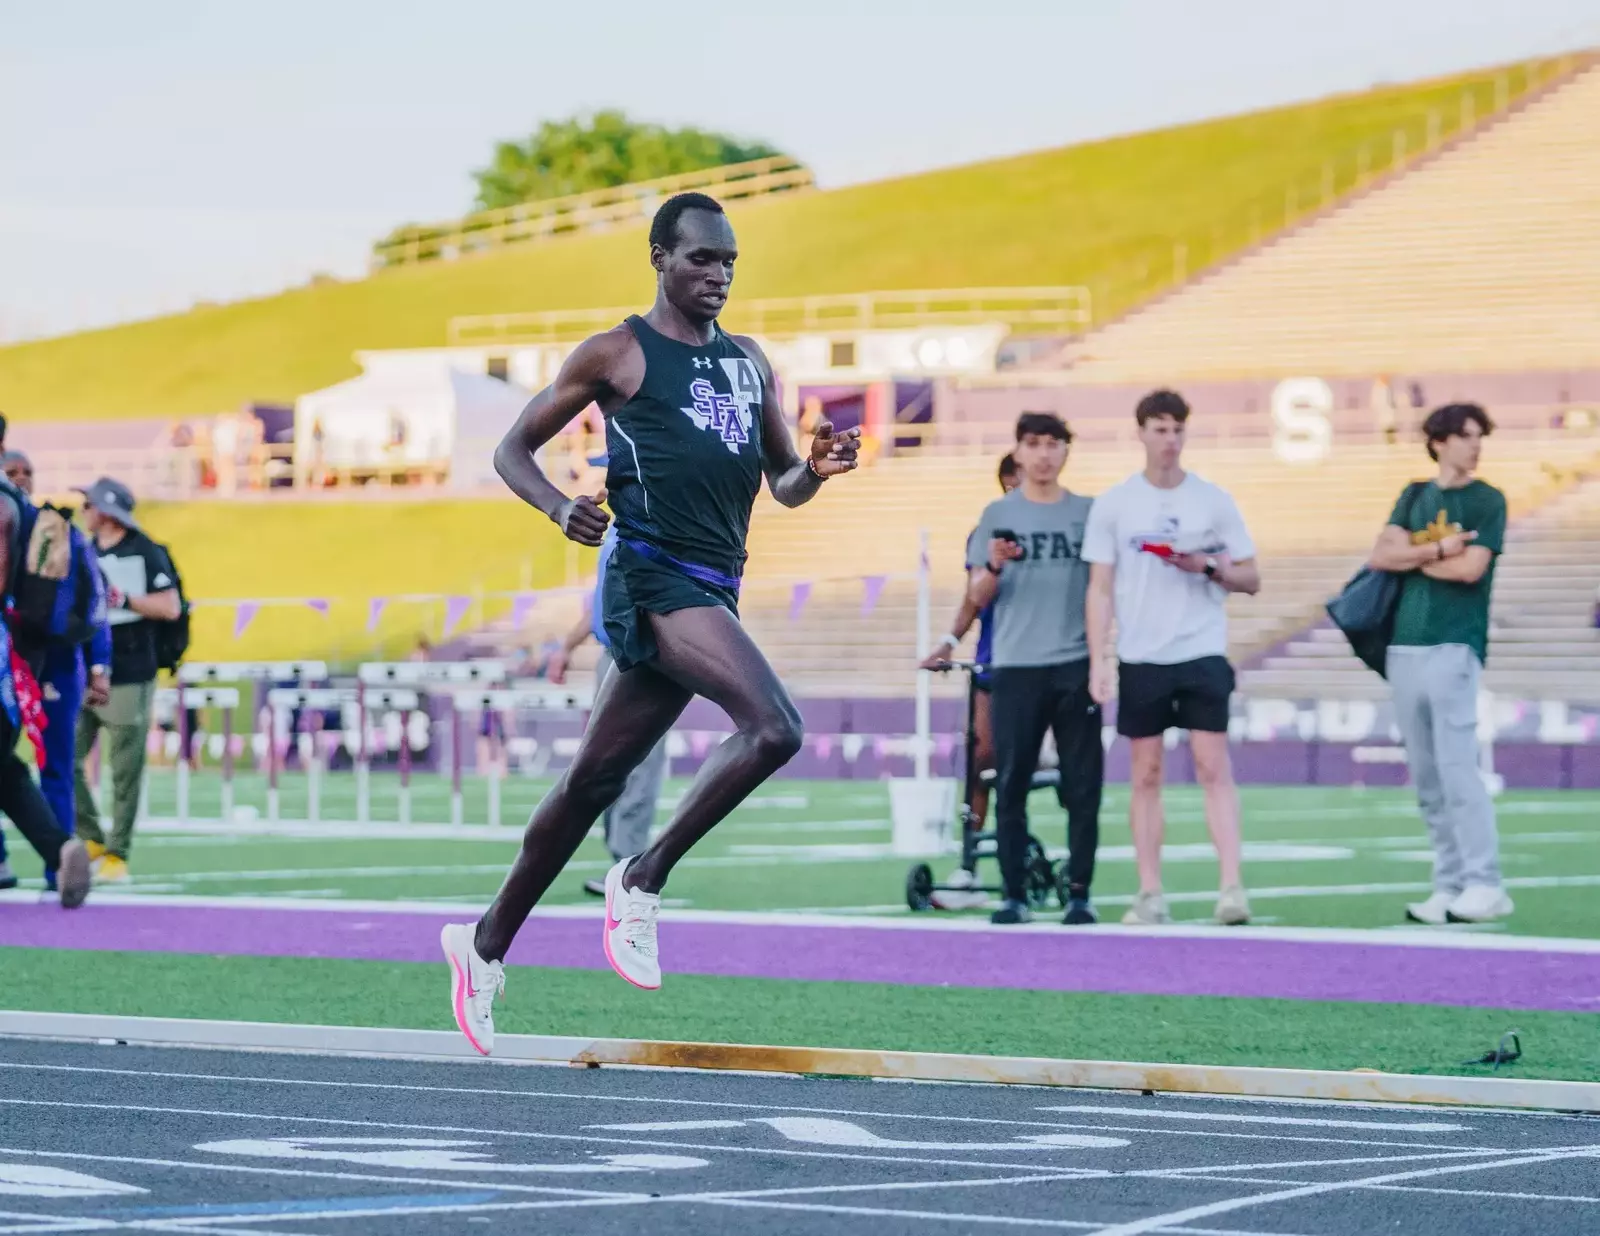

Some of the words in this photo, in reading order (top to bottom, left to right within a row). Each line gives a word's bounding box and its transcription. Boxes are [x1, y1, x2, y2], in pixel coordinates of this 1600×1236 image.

[690, 378, 749, 443] SFA
[737, 360, 760, 404] 4
[1271, 376, 1333, 465] S
